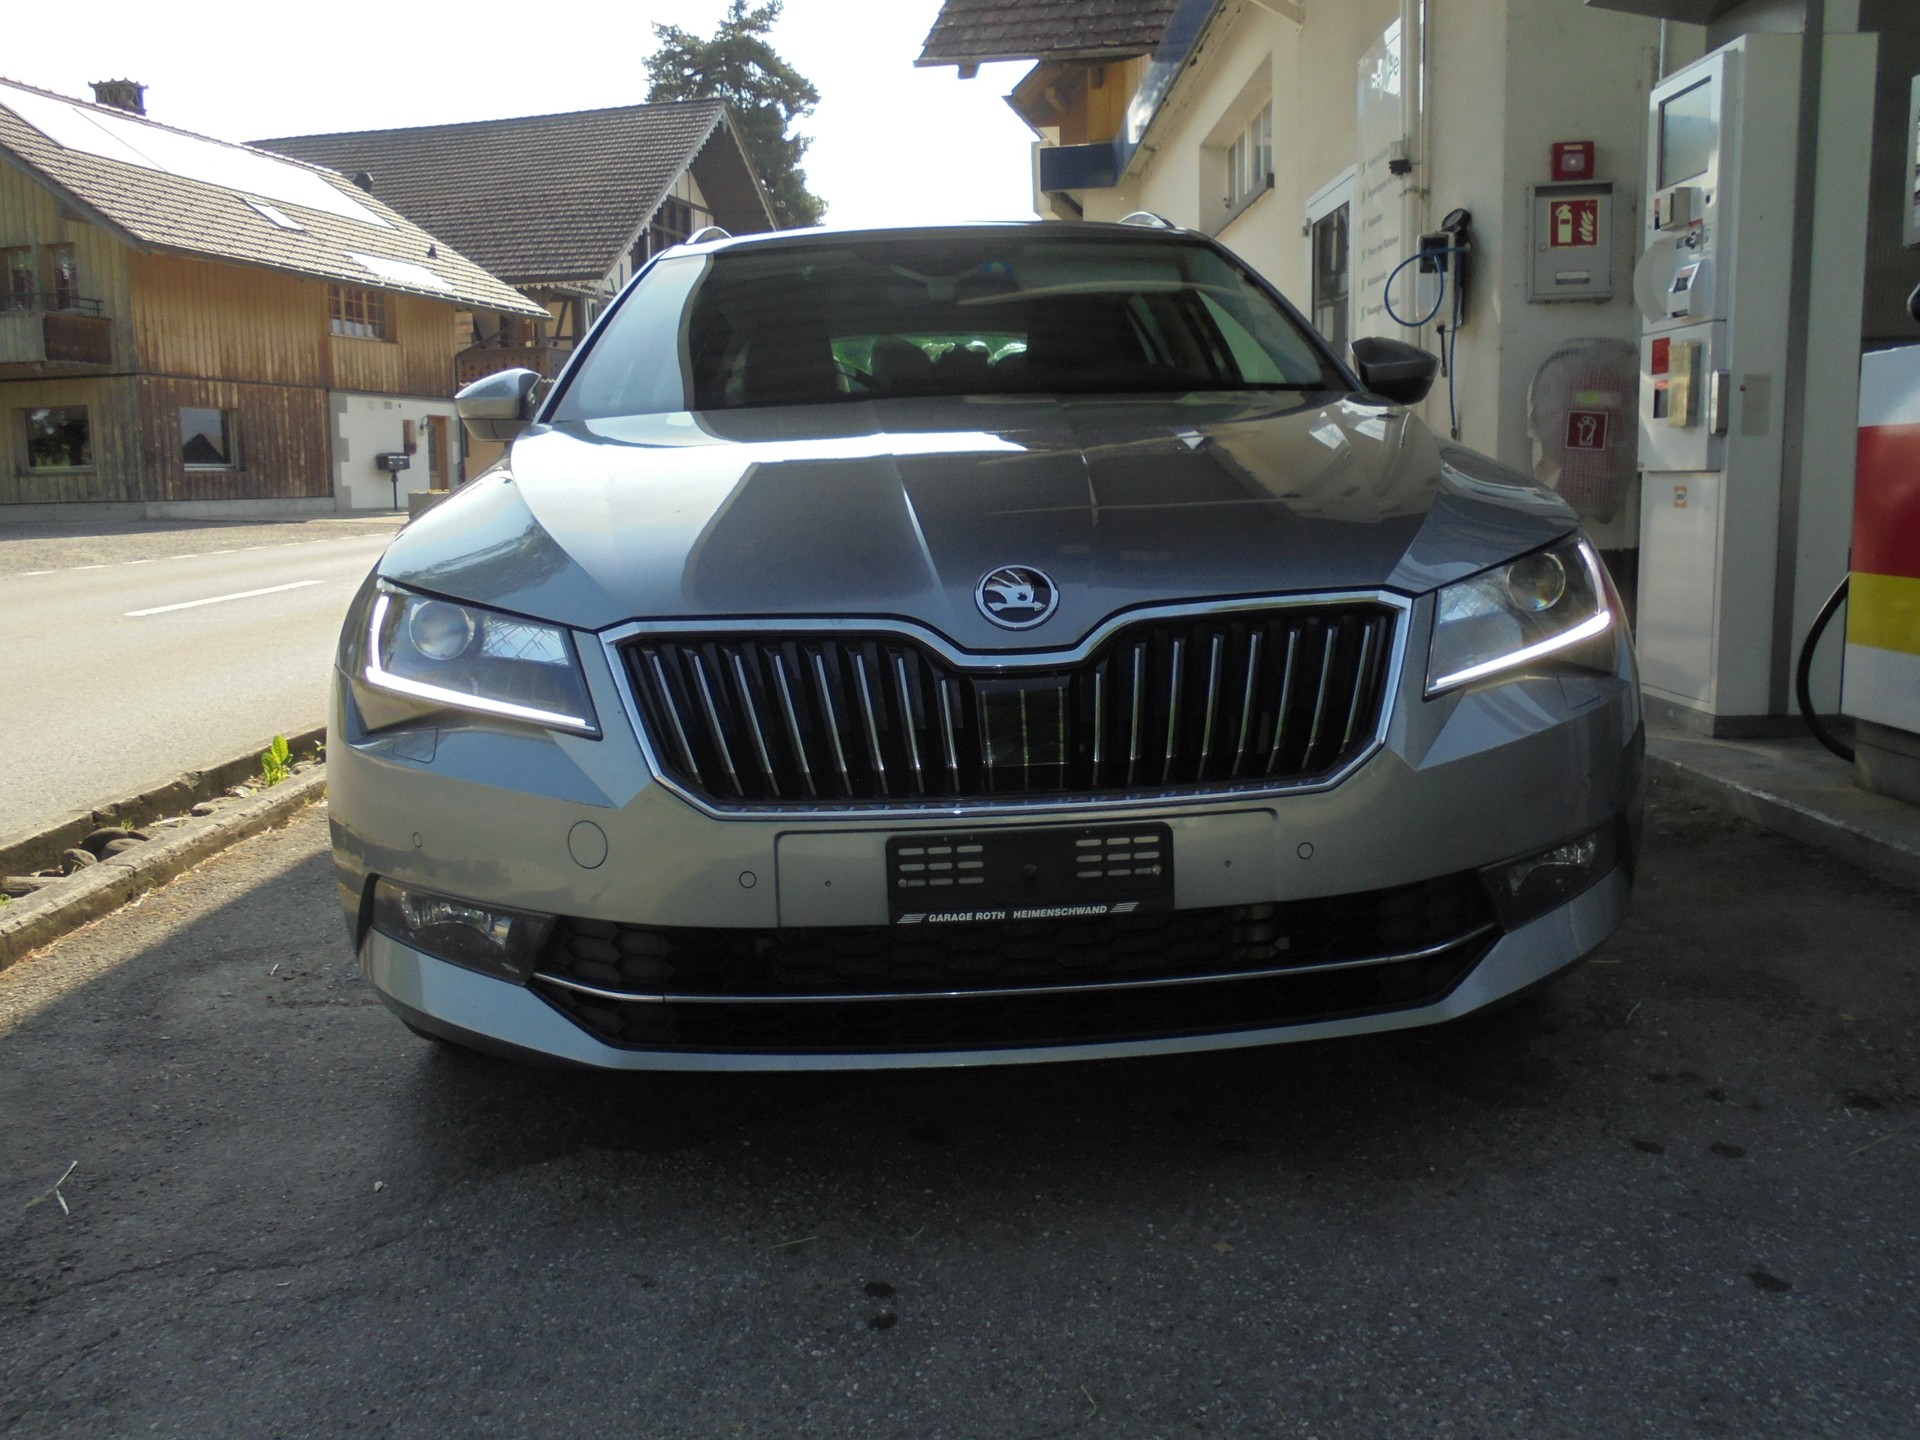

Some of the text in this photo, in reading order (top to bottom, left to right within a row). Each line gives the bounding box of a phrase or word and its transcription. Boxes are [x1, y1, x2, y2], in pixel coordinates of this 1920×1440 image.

[928, 905, 1108, 923] GARAGE ROTH HEIMENSCHWAND
